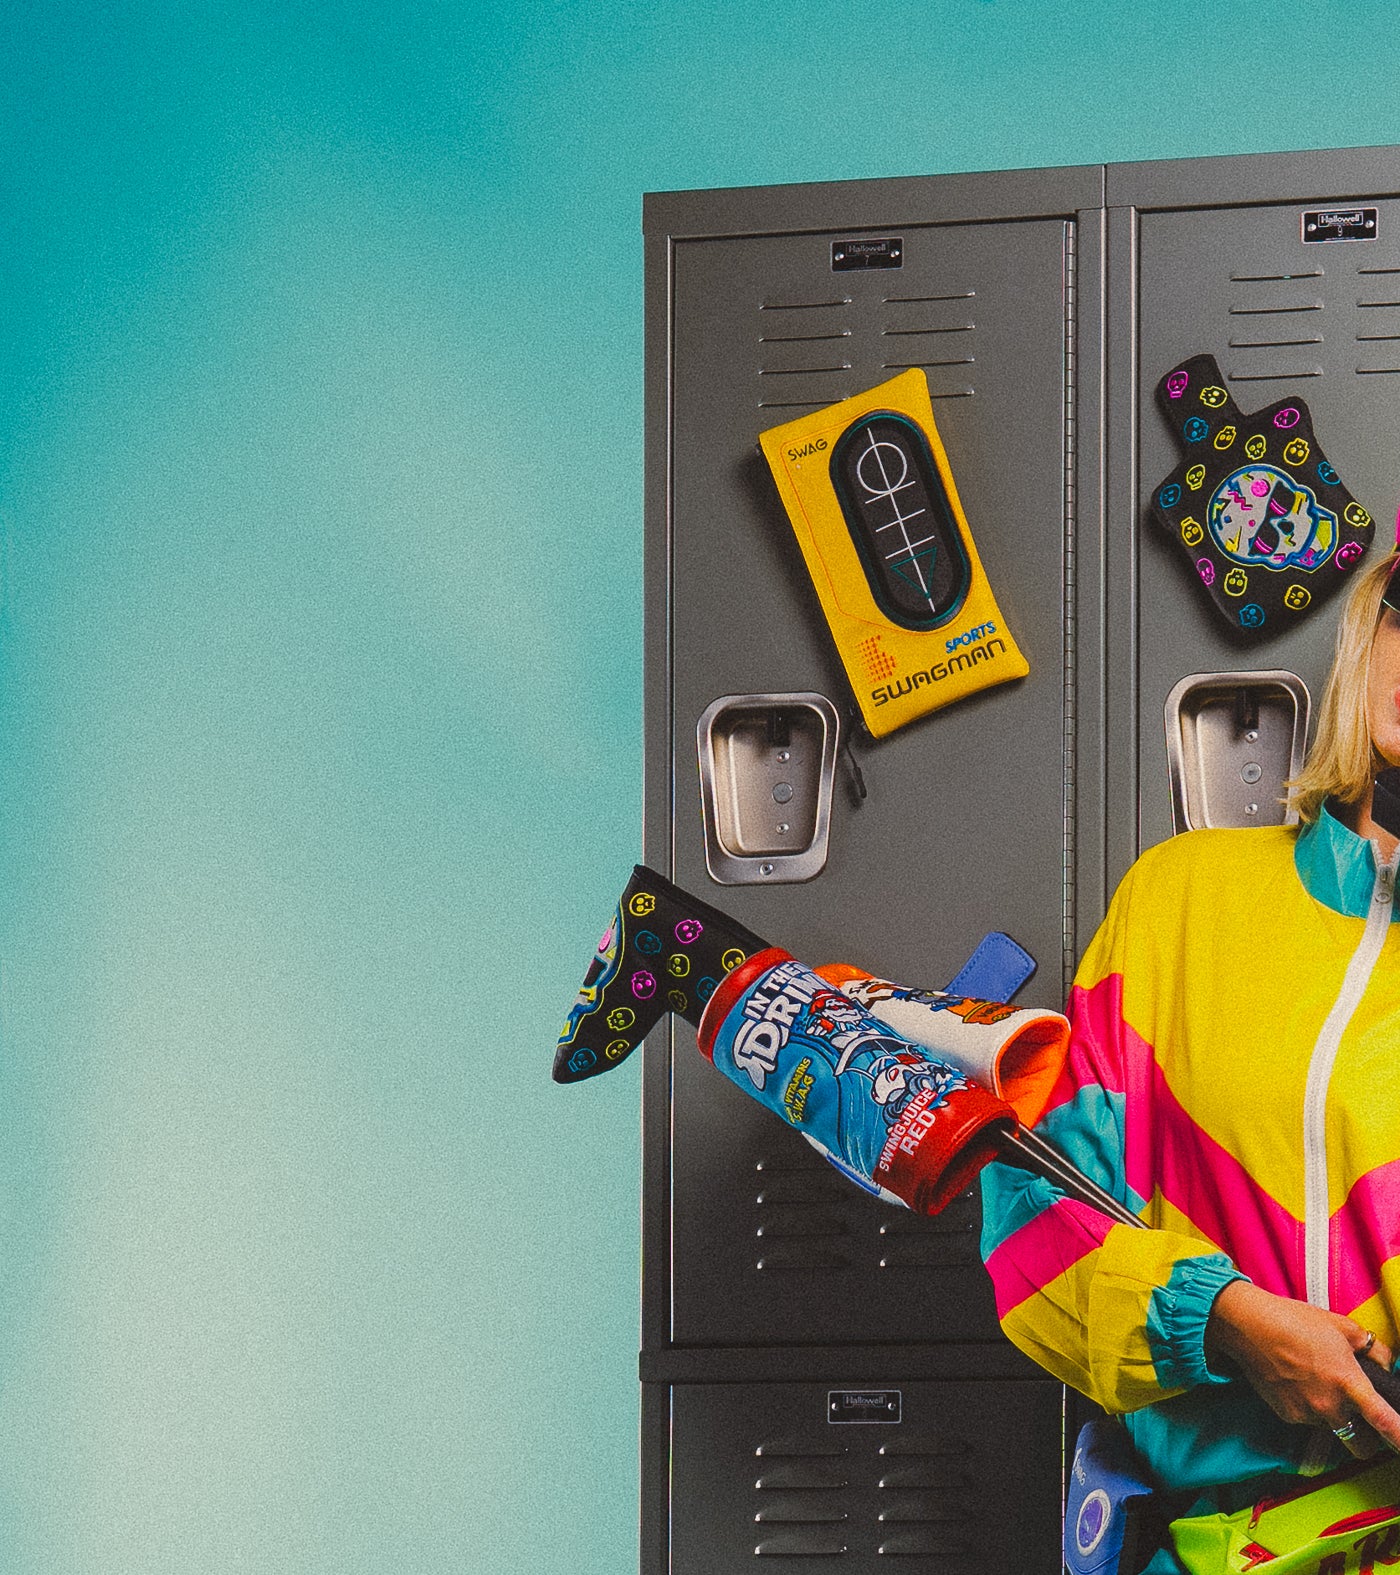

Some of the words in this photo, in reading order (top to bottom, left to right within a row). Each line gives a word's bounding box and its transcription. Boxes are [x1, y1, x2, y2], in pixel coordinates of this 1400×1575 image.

[1320, 213, 1360, 224] Hallowell
[1337, 224, 1344, 237] 9
[848, 243, 887, 253] Hallowell
[788, 438, 828, 461] SWAG
[945, 621, 997, 654] SPORTS
[871, 638, 1006, 707] SWAGMAN
[744, 992, 772, 1020] IN
[762, 962, 802, 991] THE
[738, 966, 838, 1068] DRIN
[785, 1057, 811, 1104] VITAMINS
[899, 1110, 936, 1156] RED
[846, 1395, 884, 1405] Hallowell
